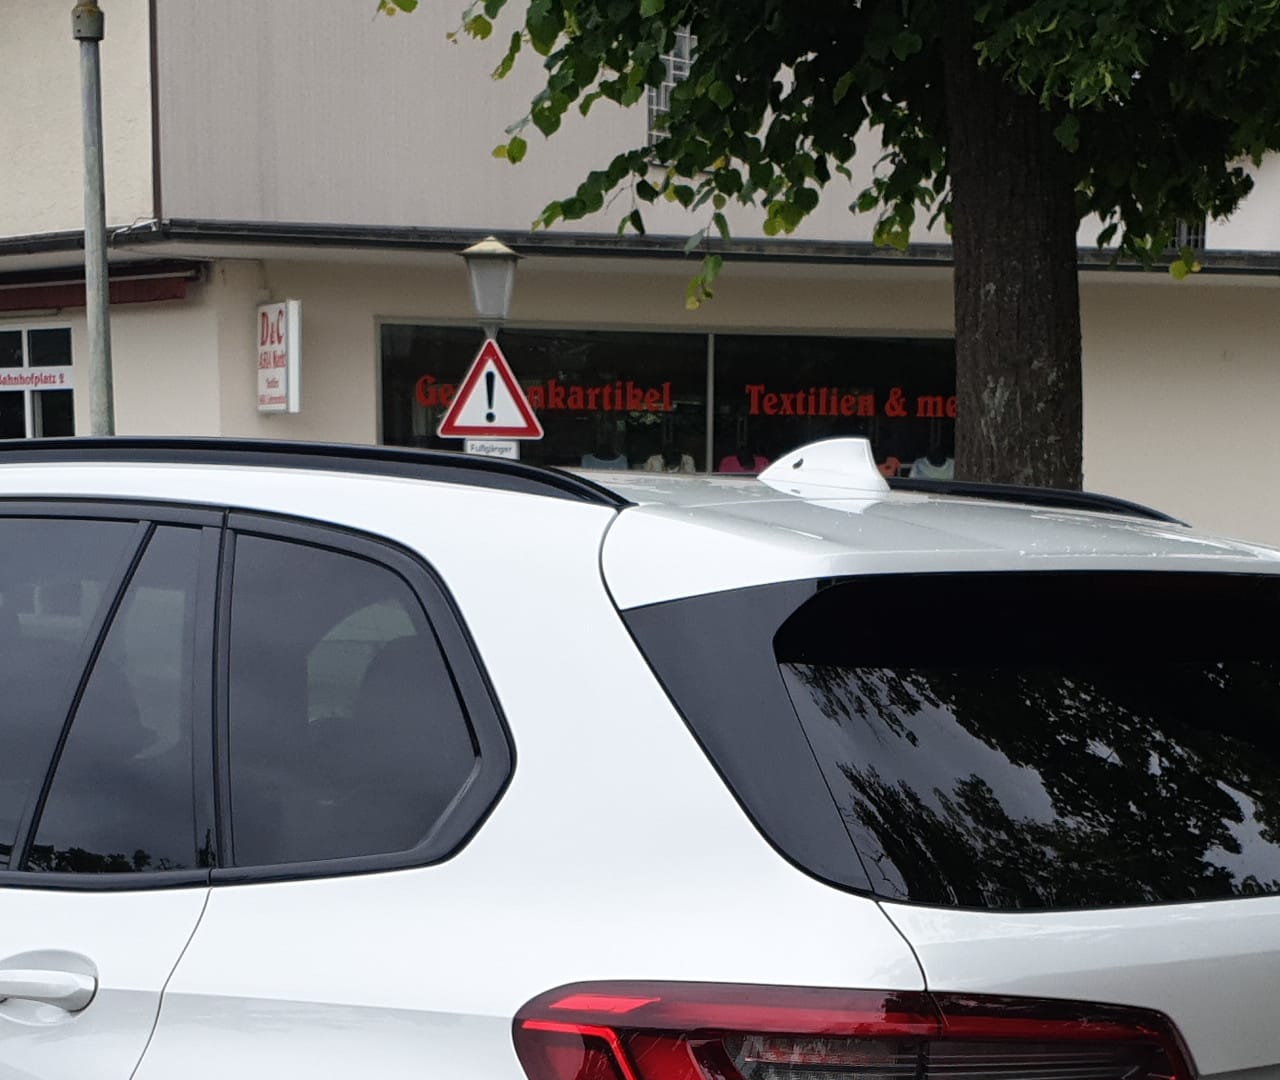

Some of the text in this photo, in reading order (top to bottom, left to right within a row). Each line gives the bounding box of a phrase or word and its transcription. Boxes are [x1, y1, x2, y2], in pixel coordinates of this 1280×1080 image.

[415, 374, 674, 412] Genkartikel
[746, 384, 876, 416] Textilien
[884, 387, 907, 417] &
